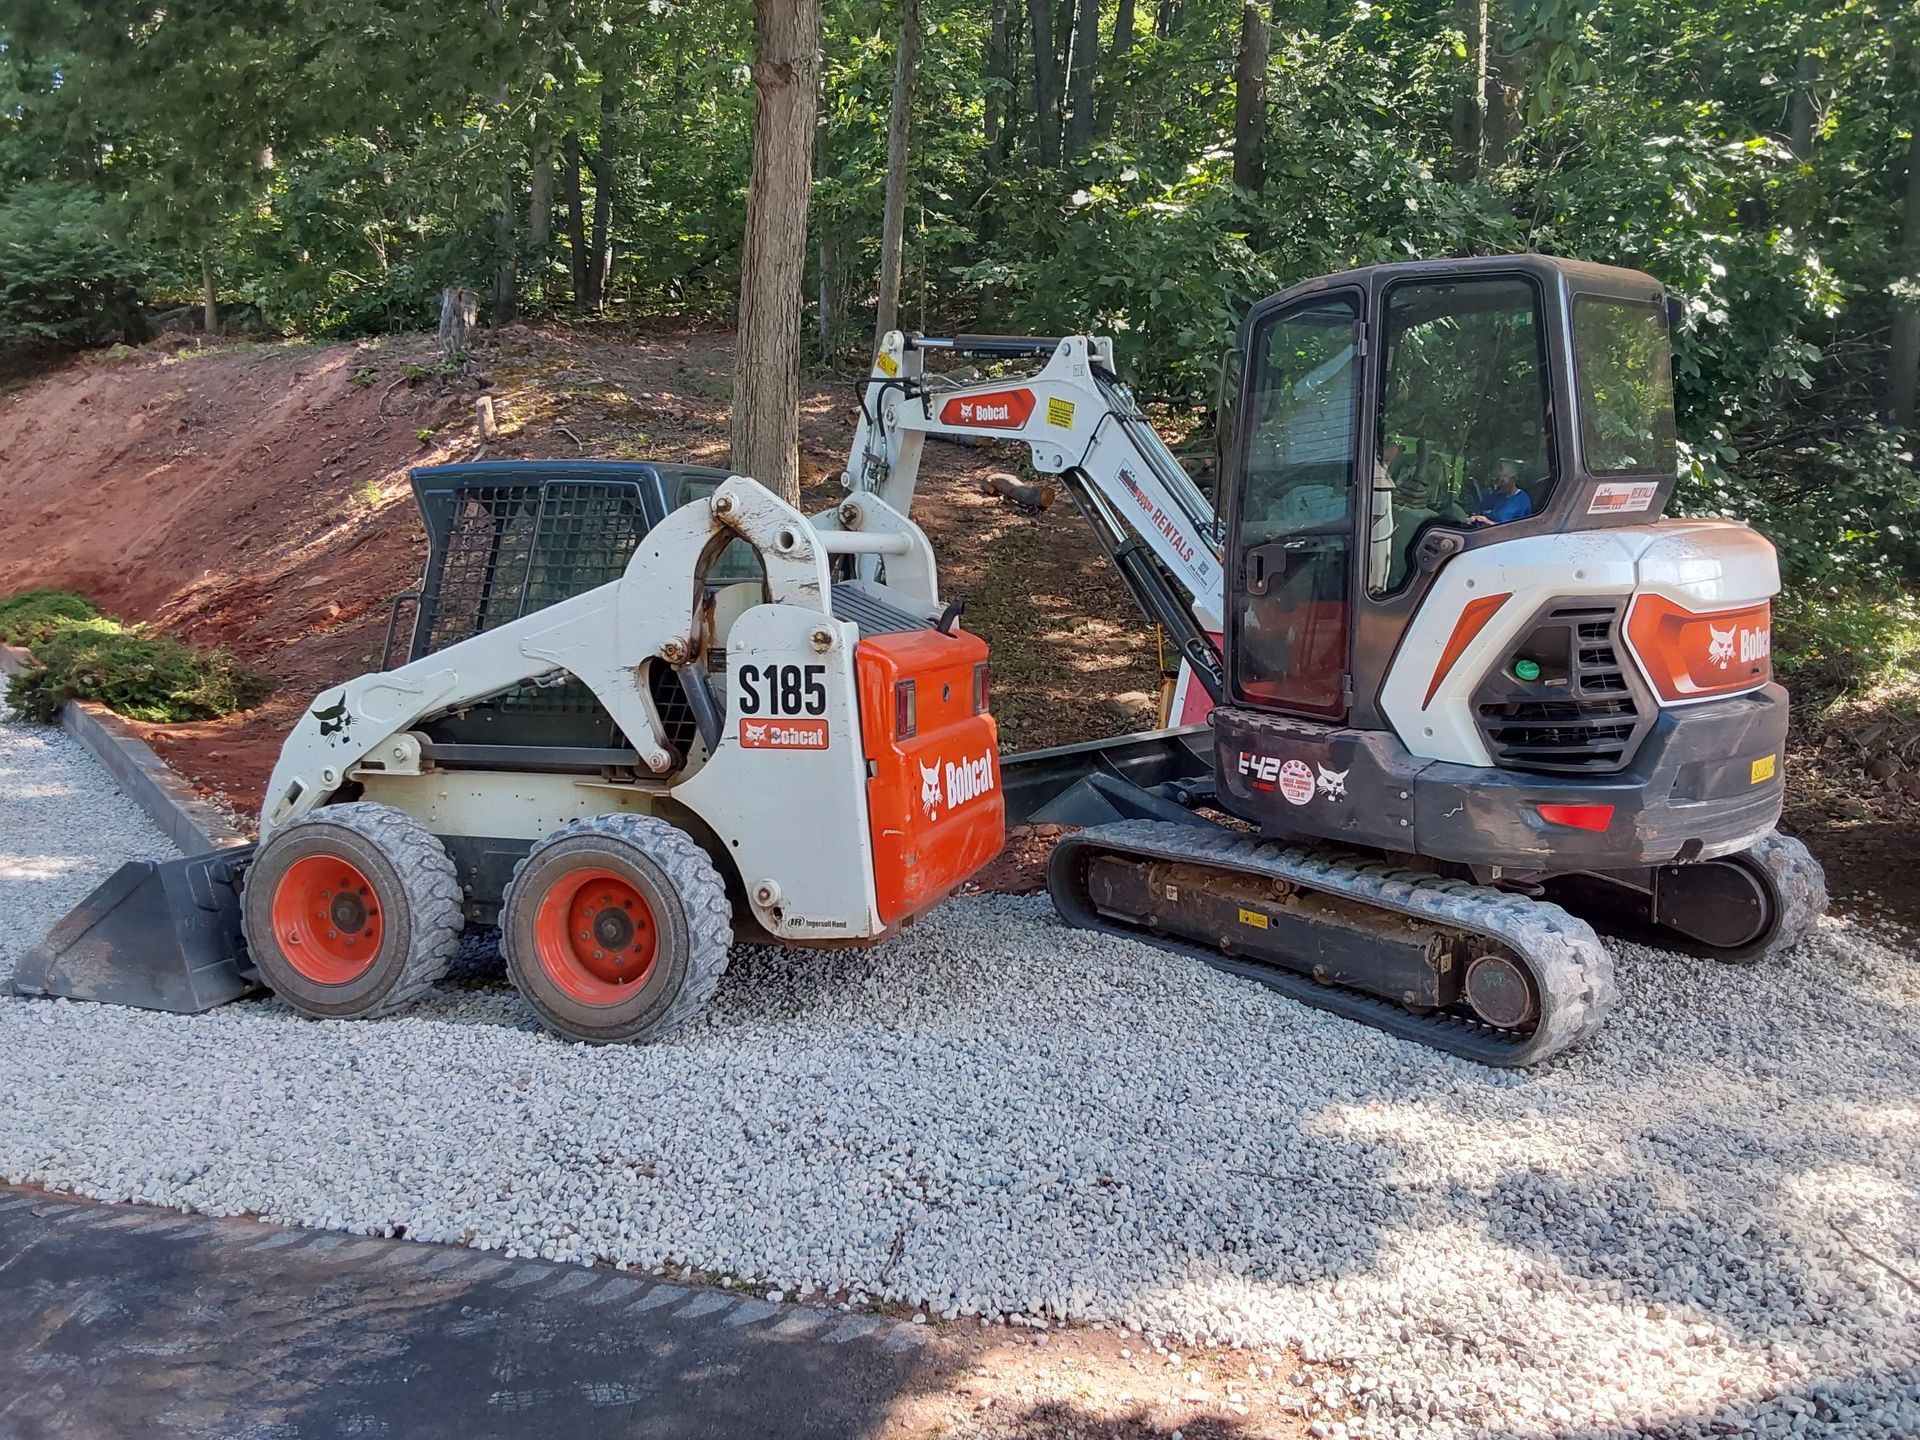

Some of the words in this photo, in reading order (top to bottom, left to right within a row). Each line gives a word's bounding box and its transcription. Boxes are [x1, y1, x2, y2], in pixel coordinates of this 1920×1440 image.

[976, 404, 1009, 421] Bobcat
[1151, 508, 1194, 563] RENTALS
[739, 664, 826, 716] S185
[770, 727, 824, 746] Bobcat
[945, 748, 994, 810] Bobcat
[1238, 752, 1281, 782] E42
[806, 920, 831, 928] Ingersoll
